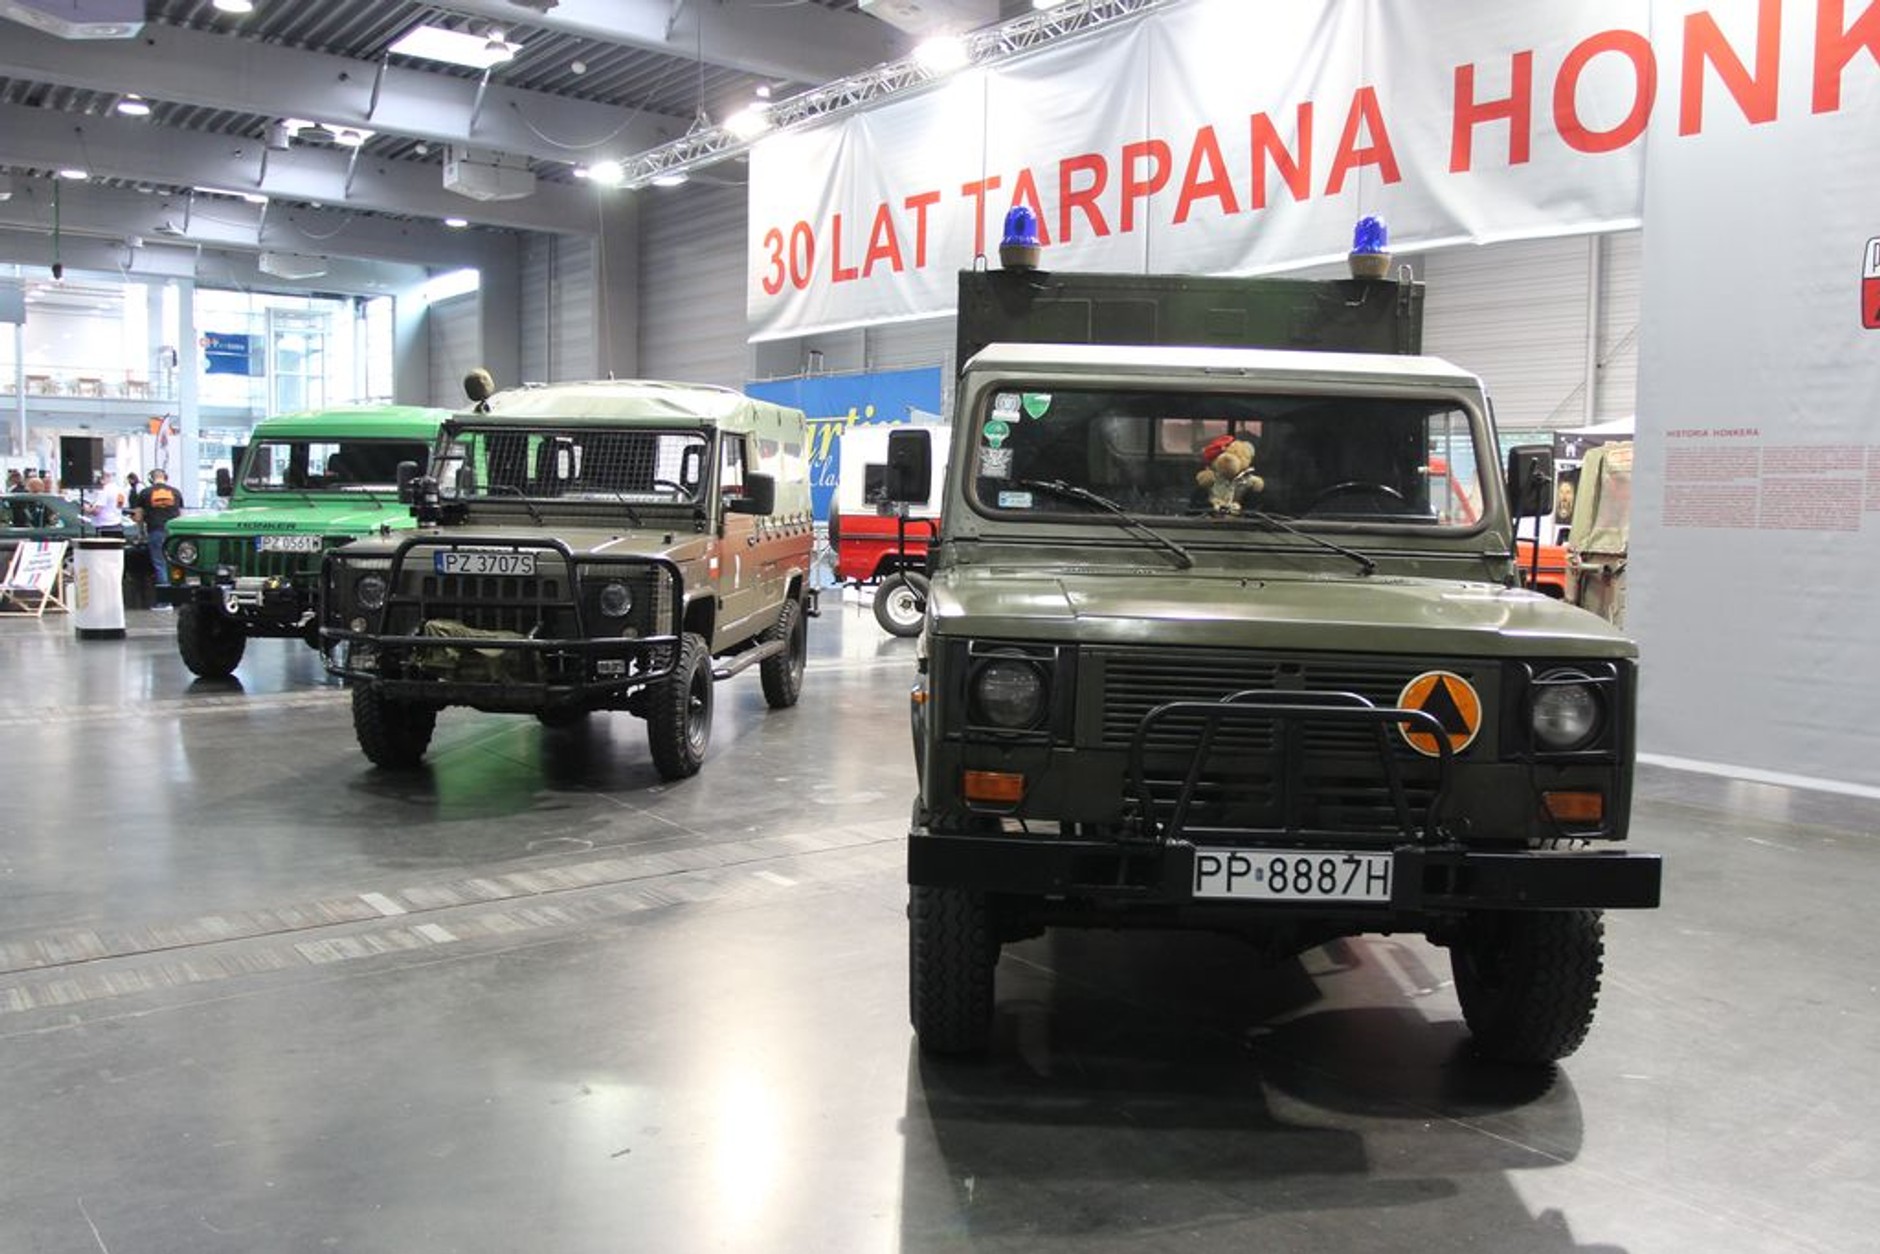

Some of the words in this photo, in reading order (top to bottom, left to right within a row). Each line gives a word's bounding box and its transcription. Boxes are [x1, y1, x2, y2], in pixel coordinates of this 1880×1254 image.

[762, 220, 815, 295] 30
[831, 190, 941, 283] LAT
[961, 85, 1402, 258] TARPANA
[1450, 0, 1880, 174] HONK
[445, 554, 471, 572] PZ
[477, 555, 532, 574] 3707S
[1196, 855, 1251, 893] PP
[1268, 857, 1389, 896] 8887H
